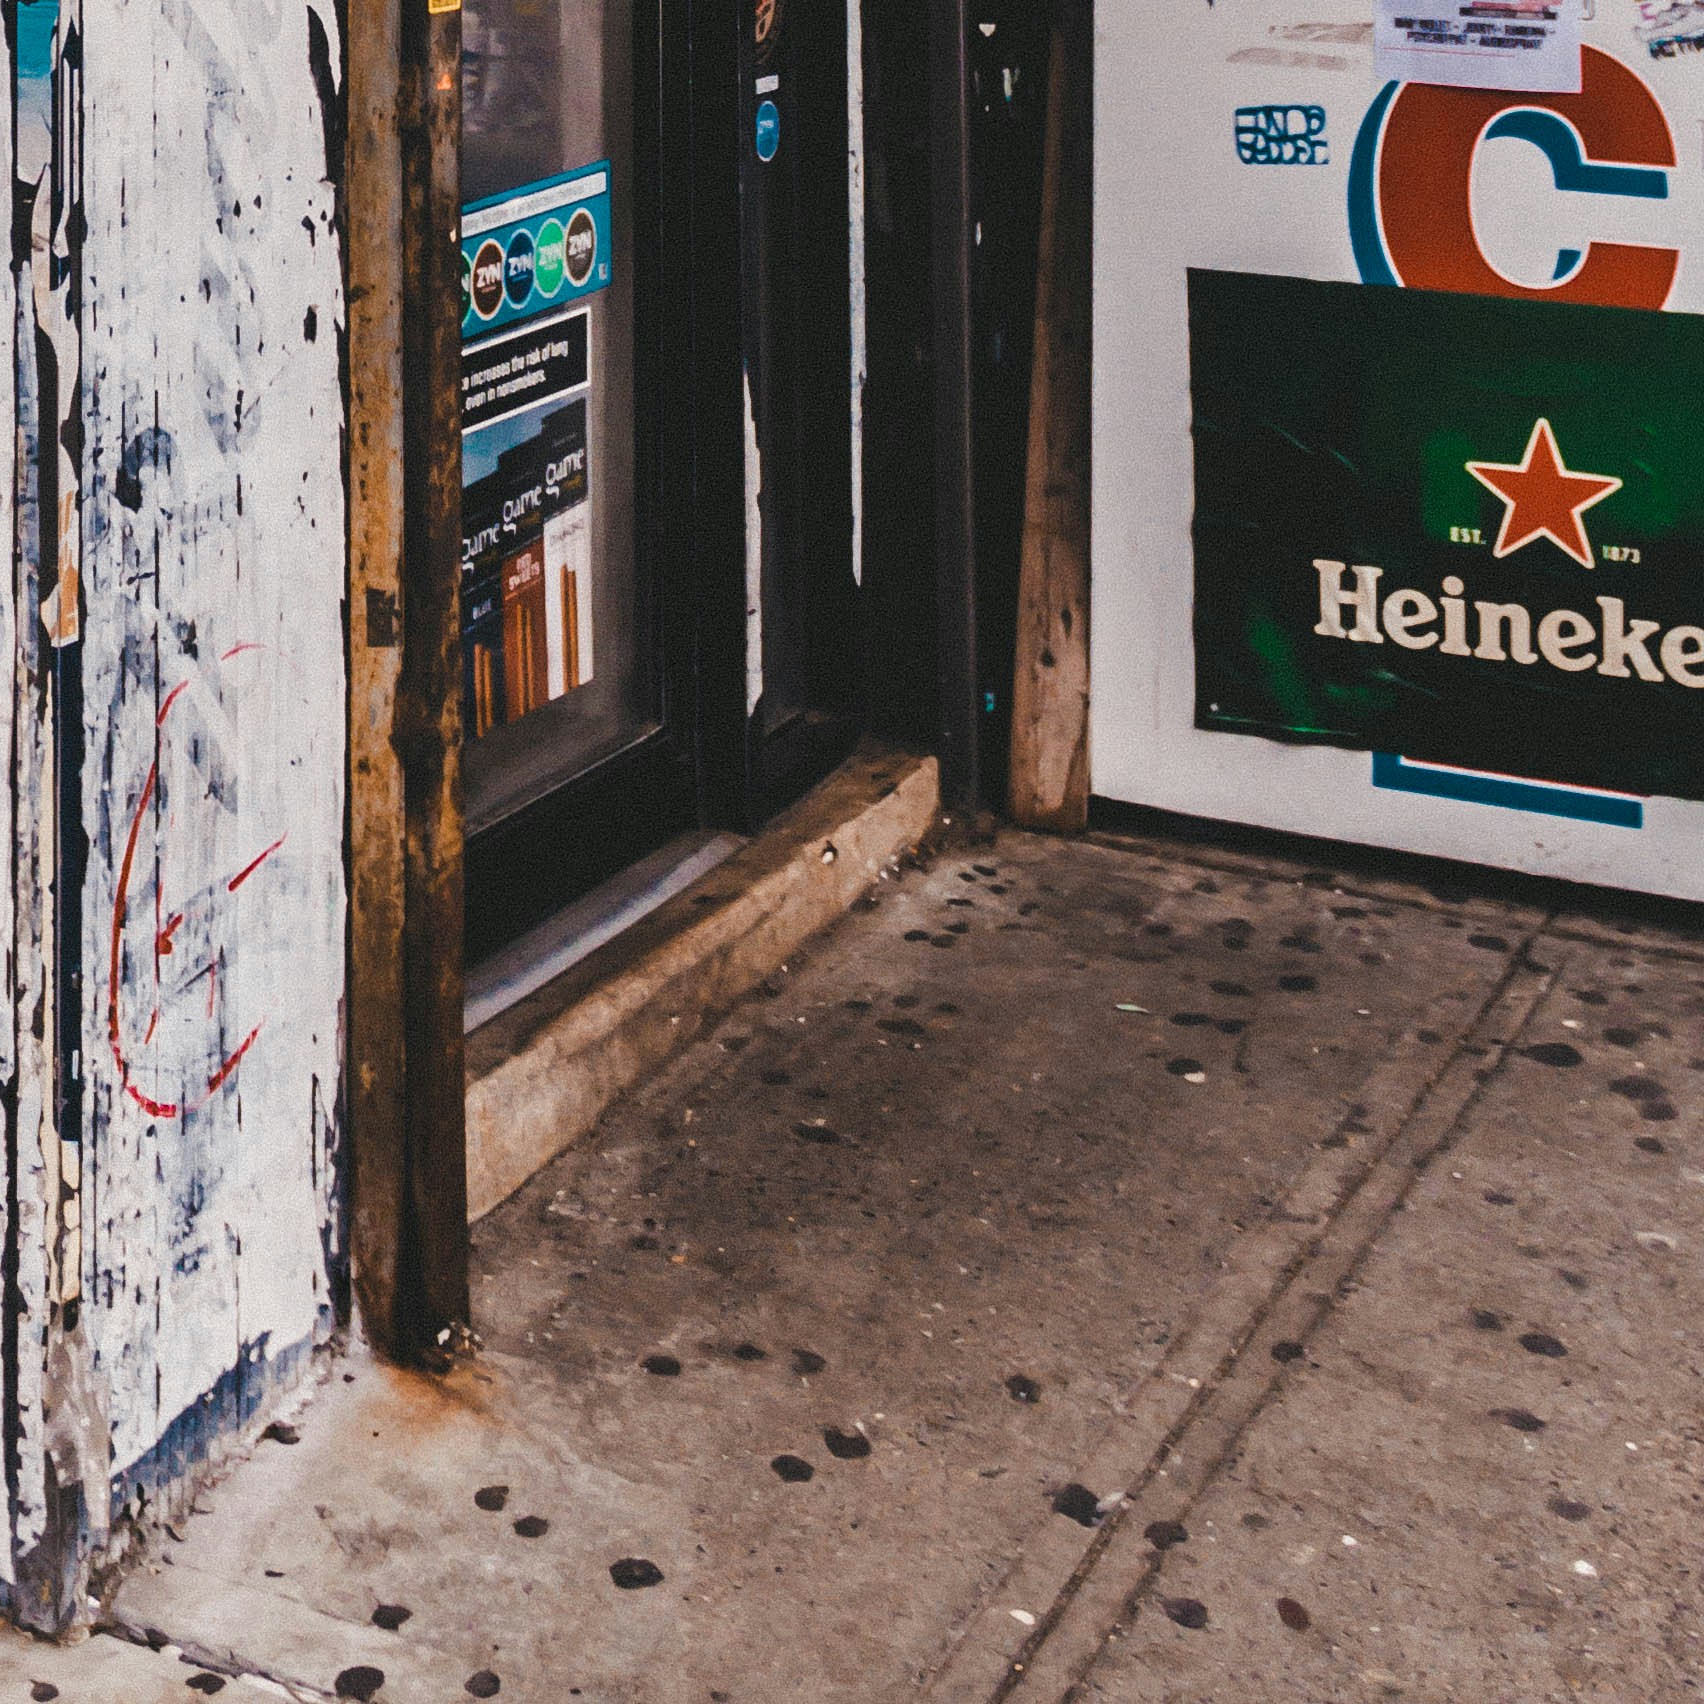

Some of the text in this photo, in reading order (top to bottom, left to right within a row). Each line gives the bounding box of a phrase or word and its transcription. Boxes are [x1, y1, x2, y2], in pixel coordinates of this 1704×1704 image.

[539, 242, 563, 266] ZYN
[569, 230, 592, 256] ZYN
[477, 262, 502, 289] ZYN
[509, 252, 534, 277] ZYN
[1449, 526, 1641, 564] EST. 1873
[1312, 558, 1704, 689] Heineke
